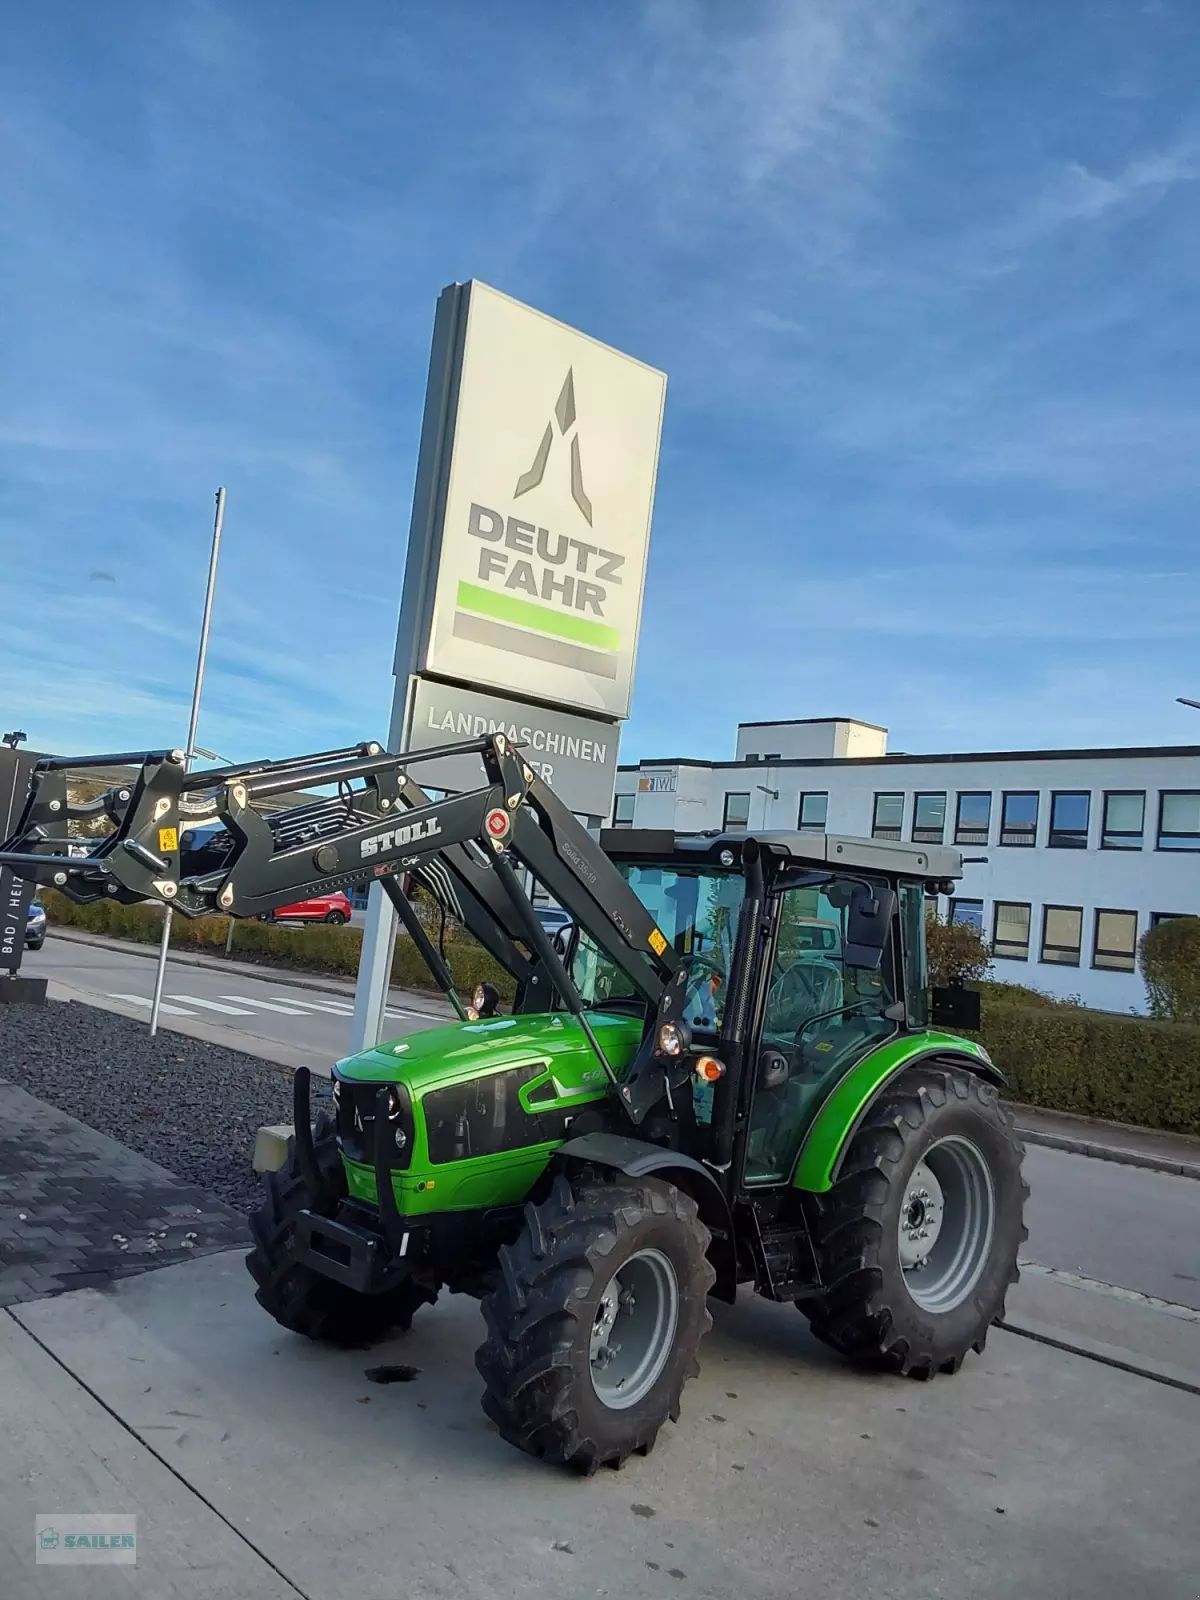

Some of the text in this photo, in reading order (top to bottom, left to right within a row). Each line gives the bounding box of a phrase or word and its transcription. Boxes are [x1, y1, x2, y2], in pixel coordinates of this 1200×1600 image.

[468, 502, 625, 585] DEUTZ
[478, 547, 607, 617] FAHR
[427, 706, 607, 764] LANDMASCHINEN
[360, 817, 442, 858] STOLL
[1, 926, 16, 954] BAD
